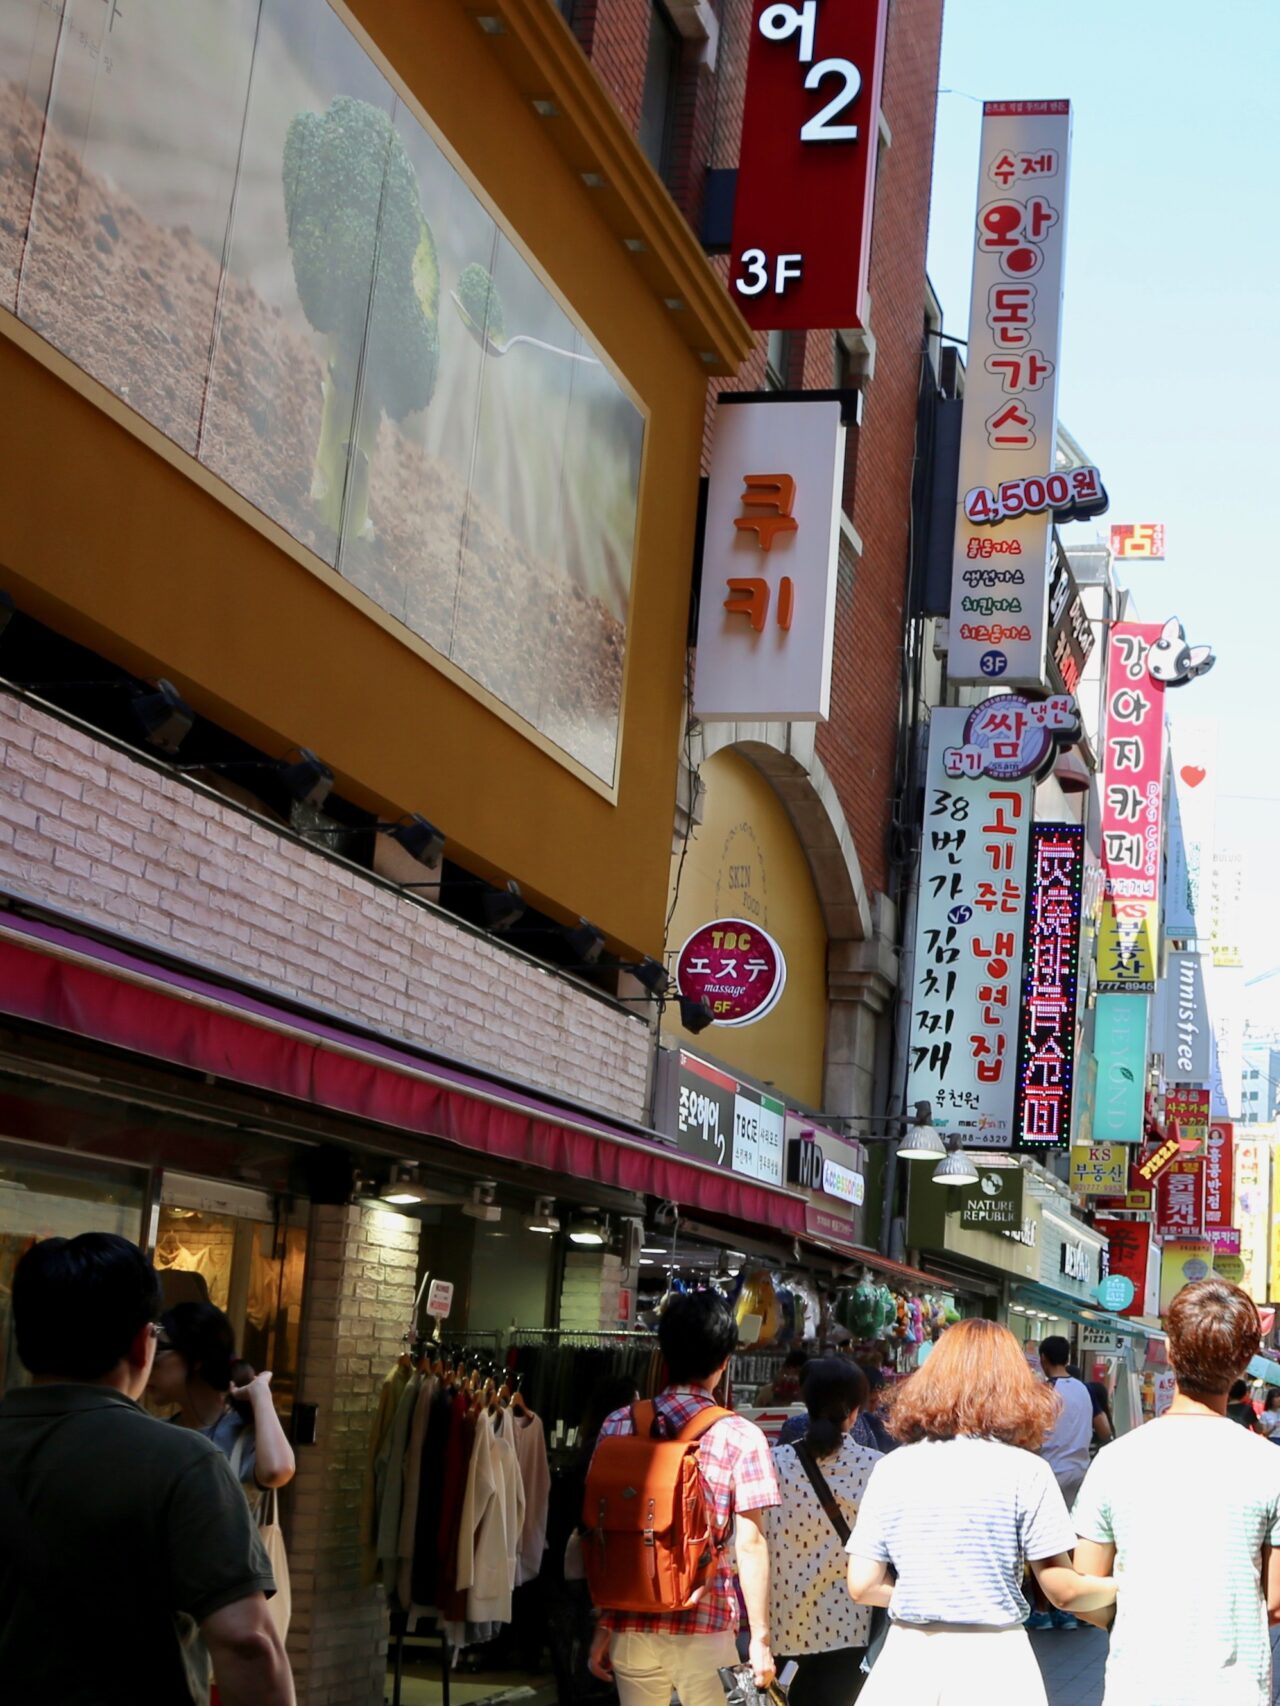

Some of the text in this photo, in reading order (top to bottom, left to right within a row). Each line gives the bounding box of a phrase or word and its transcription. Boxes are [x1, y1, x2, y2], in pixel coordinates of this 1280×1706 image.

[801, 58, 861, 141] 2
[994, 154, 1052, 185] 수제
[735, 249, 802, 295] 3F
[983, 201, 1052, 444] 왕돈가스
[968, 469, 1098, 519] 4,500원
[968, 538, 1022, 558] 불돈가스
[963, 569, 1025, 588] 생선가스
[961, 596, 1022, 615] 치킨가스
[960, 624, 1031, 644] 치즈돈가스
[982, 656, 1006, 671] 3F
[1030, 700, 1068, 724] 냉면
[981, 712, 1028, 758] 쌈
[948, 752, 982, 771] 고기
[929, 789, 969, 900] 38번가
[686, 957, 769, 982] エステ
[704, 983, 746, 997] massage
[713, 1000, 732, 1013] 5F
[911, 926, 961, 1081] 김치찌개
[1177, 960, 1199, 1072] innisfree
[1107, 1006, 1133, 1129] BEYOND
[935, 1089, 980, 1111] 육천원
[800, 1140, 824, 1190] MD
[1088, 1147, 1112, 1161] KS
[1138, 1138, 1181, 1180] PIZZA
[1073, 1163, 1124, 1183] 부동산
[963, 1211, 1015, 1222] REPUBLIC
[967, 1199, 1015, 1211] NATURE
[1083, 1335, 1111, 1344] PIZZA
